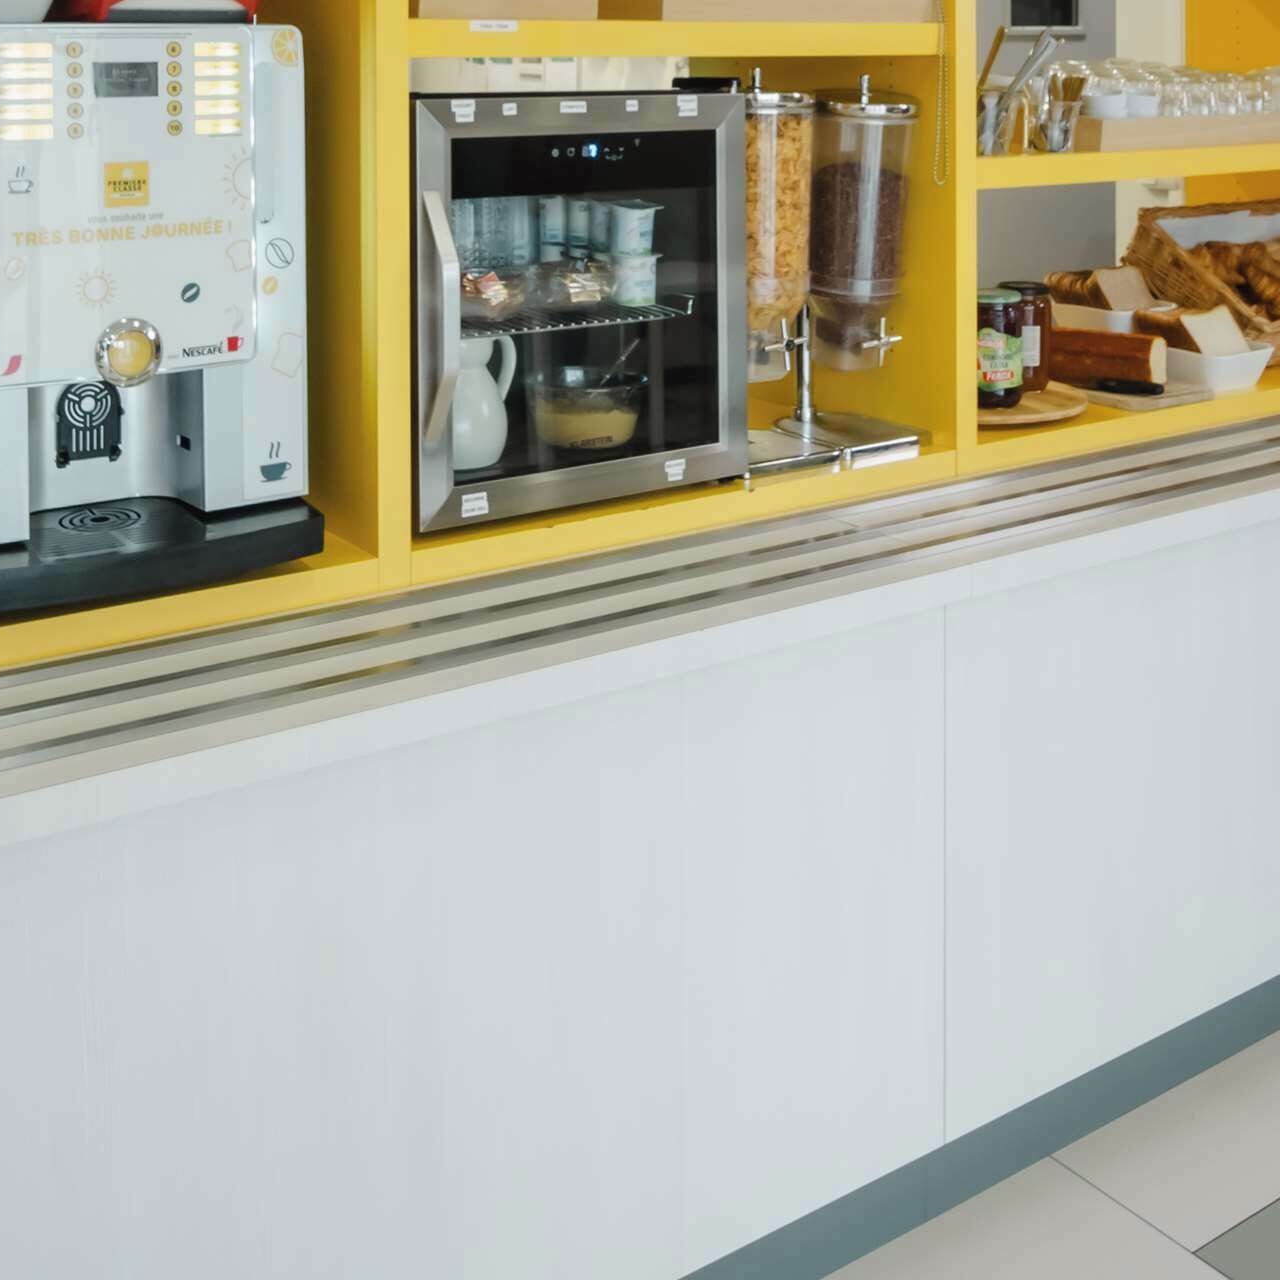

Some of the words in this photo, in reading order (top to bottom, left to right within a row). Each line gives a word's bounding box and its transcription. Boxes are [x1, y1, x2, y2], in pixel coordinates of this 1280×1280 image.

[12, 226, 63, 247] TRÈS
[69, 225, 136, 244] BONNE
[141, 217, 224, 240] JOURNÉE
[182, 341, 223, 358] NESCAFÉ
